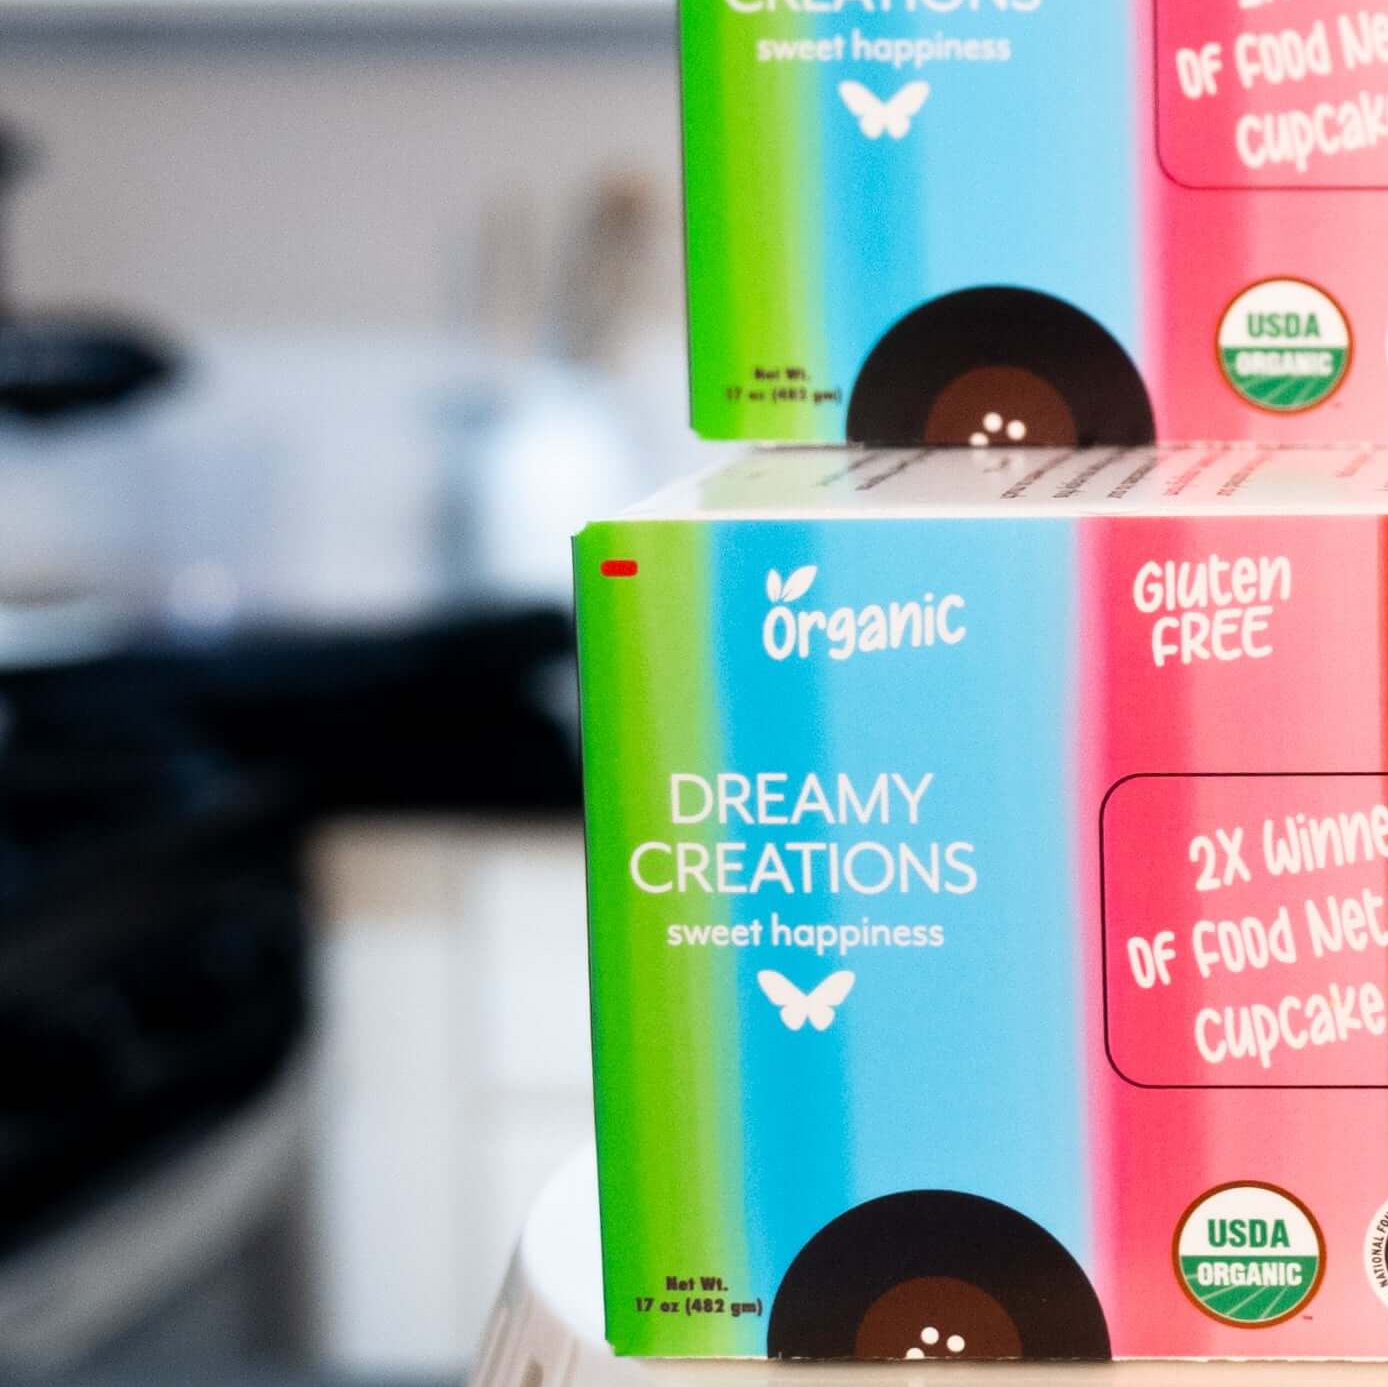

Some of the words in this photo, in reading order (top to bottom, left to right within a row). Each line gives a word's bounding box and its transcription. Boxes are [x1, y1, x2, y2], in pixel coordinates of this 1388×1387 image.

[757, 36, 845, 61] sweet
[852, 29, 1012, 68] happiness
[1248, 312, 1320, 338] USDA
[1133, 554, 1292, 613] Gluten
[763, 593, 965, 661] Organic
[1152, 605, 1273, 667] FREE
[670, 773, 934, 825] DREAMY
[630, 841, 978, 894] CREATIONS
[1189, 827, 1251, 891] 2X
[667, 919, 763, 946] sweet
[771, 913, 945, 956] happiness
[1207, 1219, 1291, 1248] USDA
[666, 1276, 694, 1291] Net
[700, 1276, 728, 1291] Wt.
[1197, 1262, 1302, 1286] ORGANIC
[636, 1297, 654, 1312] 17
[660, 1301, 680, 1312] oz
[685, 1297, 725, 1316] (482
[730, 1298, 763, 1317] gm)
